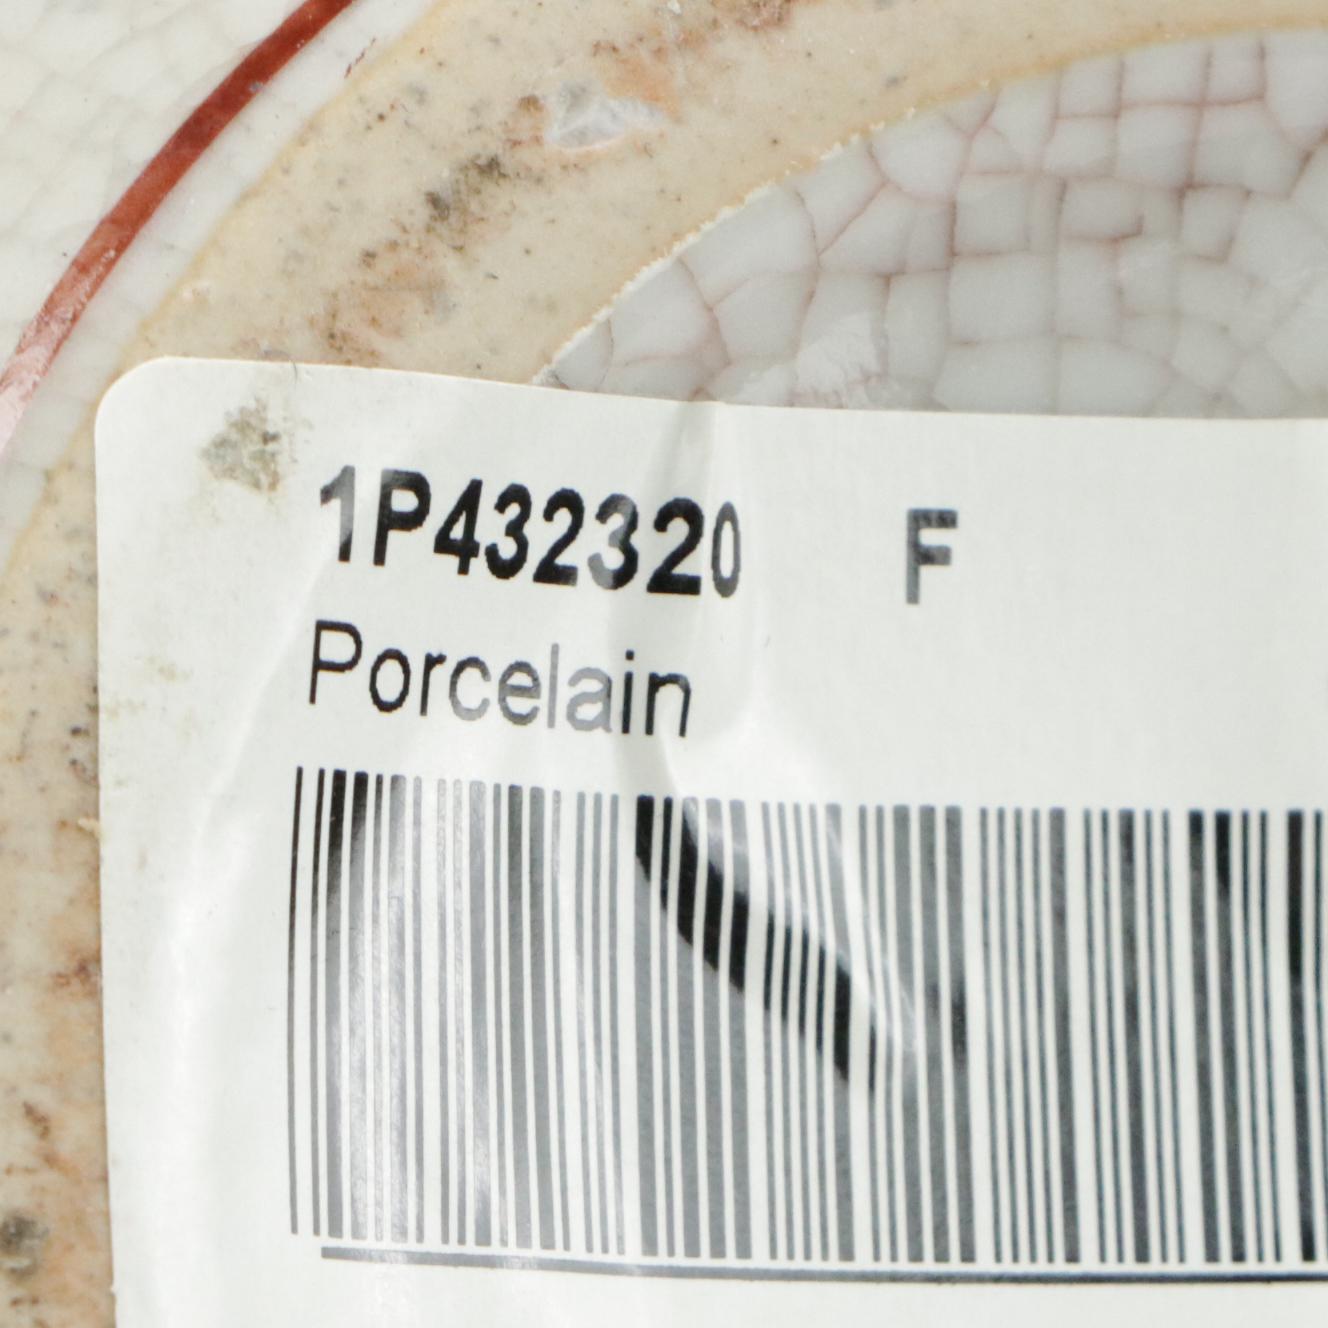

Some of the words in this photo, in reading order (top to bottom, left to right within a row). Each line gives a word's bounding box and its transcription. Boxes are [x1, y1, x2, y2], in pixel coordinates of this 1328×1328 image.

[319, 465, 742, 599] 1P432320
[906, 507, 959, 605] F
[309, 619, 692, 738] Porcelain
